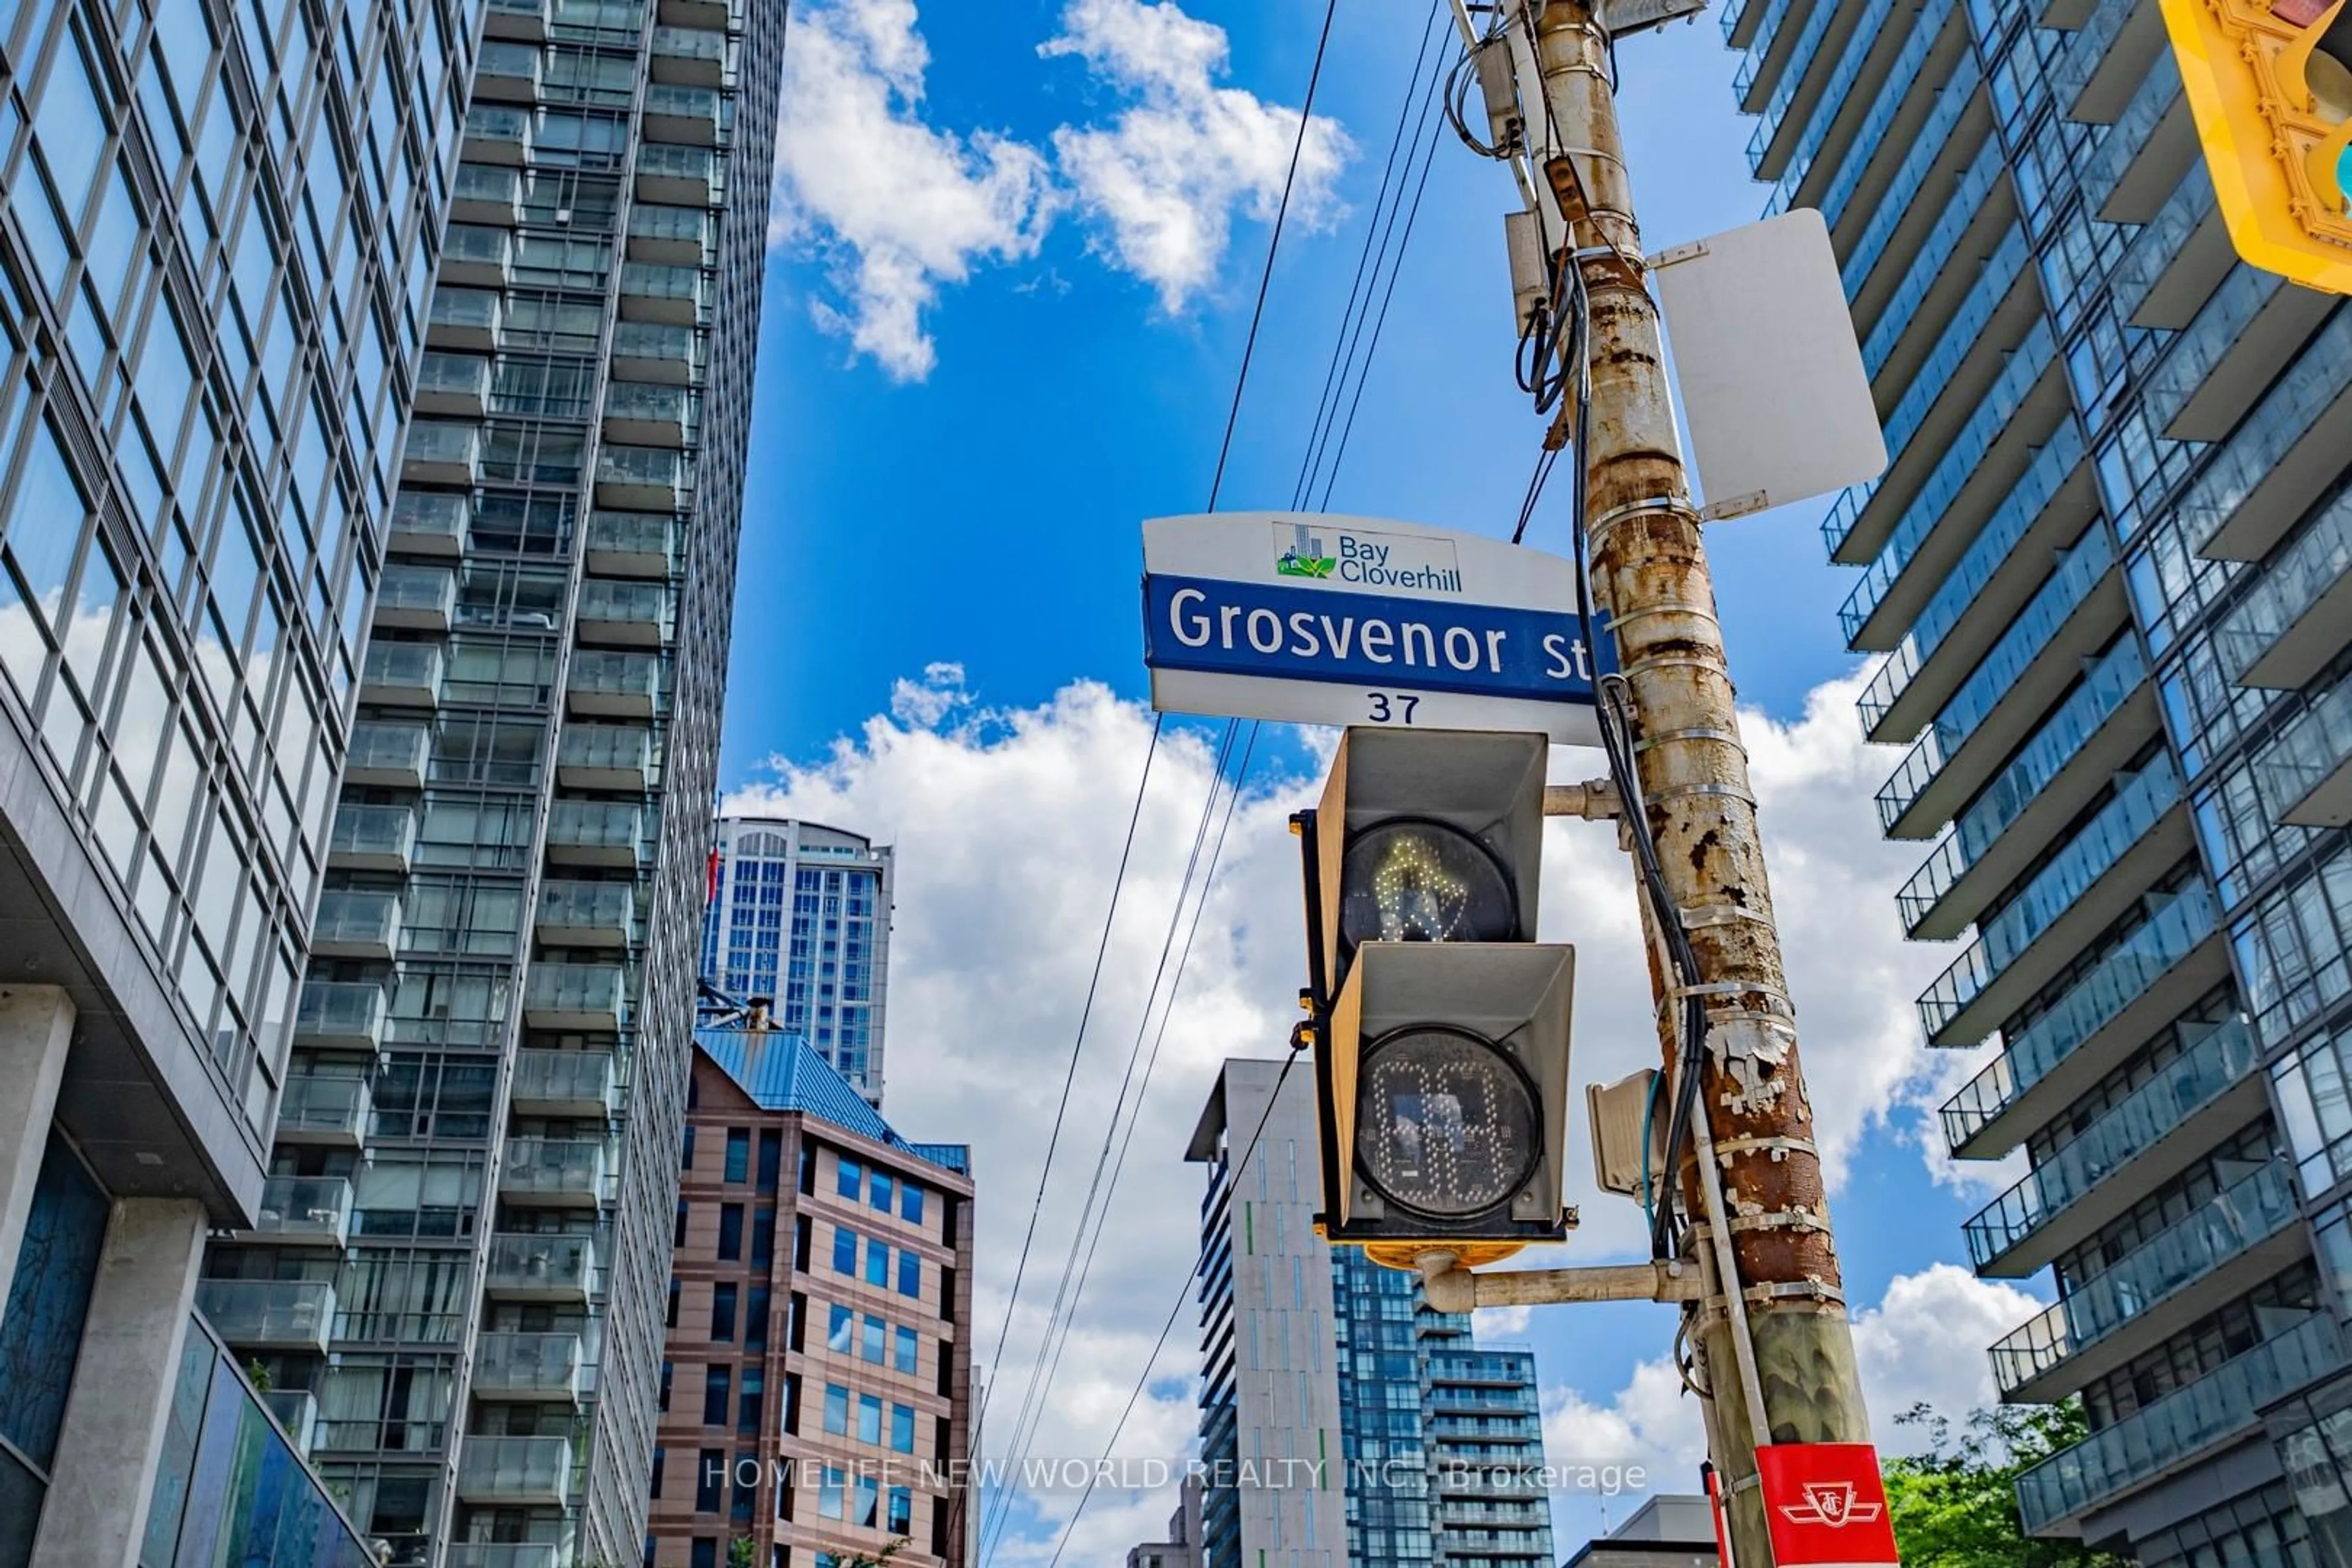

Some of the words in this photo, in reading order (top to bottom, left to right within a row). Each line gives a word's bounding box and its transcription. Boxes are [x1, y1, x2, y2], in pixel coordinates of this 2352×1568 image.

[1340, 536, 1389, 567] Bay
[1341, 560, 1461, 592] Cloverhill
[1170, 589, 1506, 673] Grosvenor
[1543, 634, 1592, 680] St
[1367, 692, 1419, 724] 37
